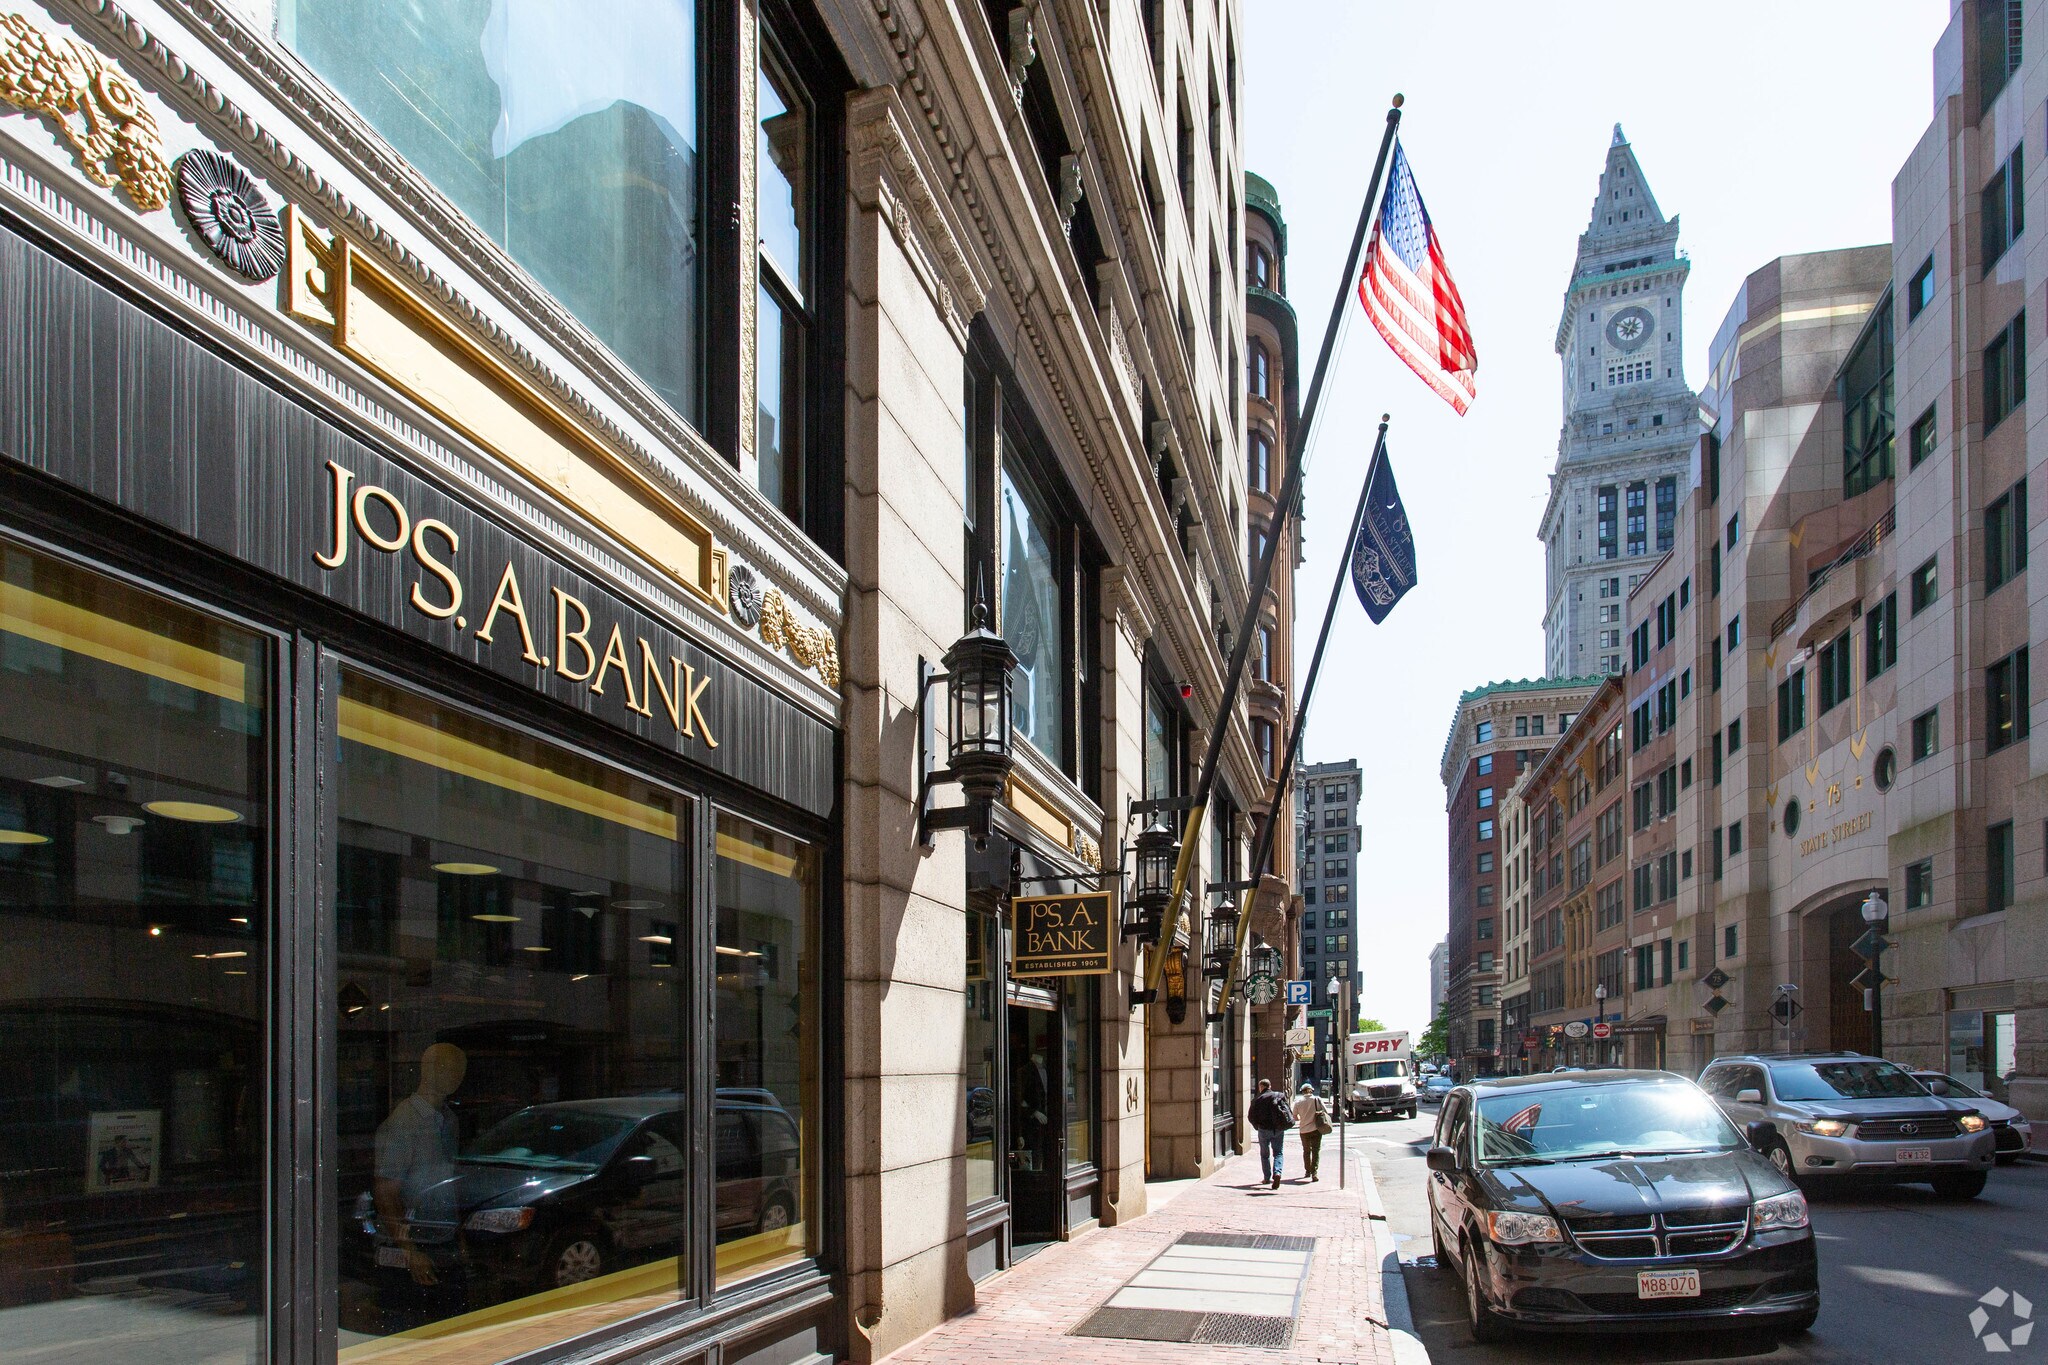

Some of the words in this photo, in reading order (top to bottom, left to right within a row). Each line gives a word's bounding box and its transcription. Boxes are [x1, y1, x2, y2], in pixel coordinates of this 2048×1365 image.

[1371, 497, 1391, 538] STATE
[1388, 536, 1416, 578] STREET
[1392, 514, 1411, 544] 84
[550, 586, 719, 749] BANK
[1826, 781, 1842, 808] 75
[1800, 831, 1828, 857] STATE
[1831, 811, 1874, 844] STREET
[1028, 930, 1095, 953] BANK
[1025, 960, 1077, 969] ESTABLISHED
[1291, 984, 1307, 1003] P
[1352, 1038, 1404, 1055] SPRY
[1126, 1076, 1139, 1113] 84
